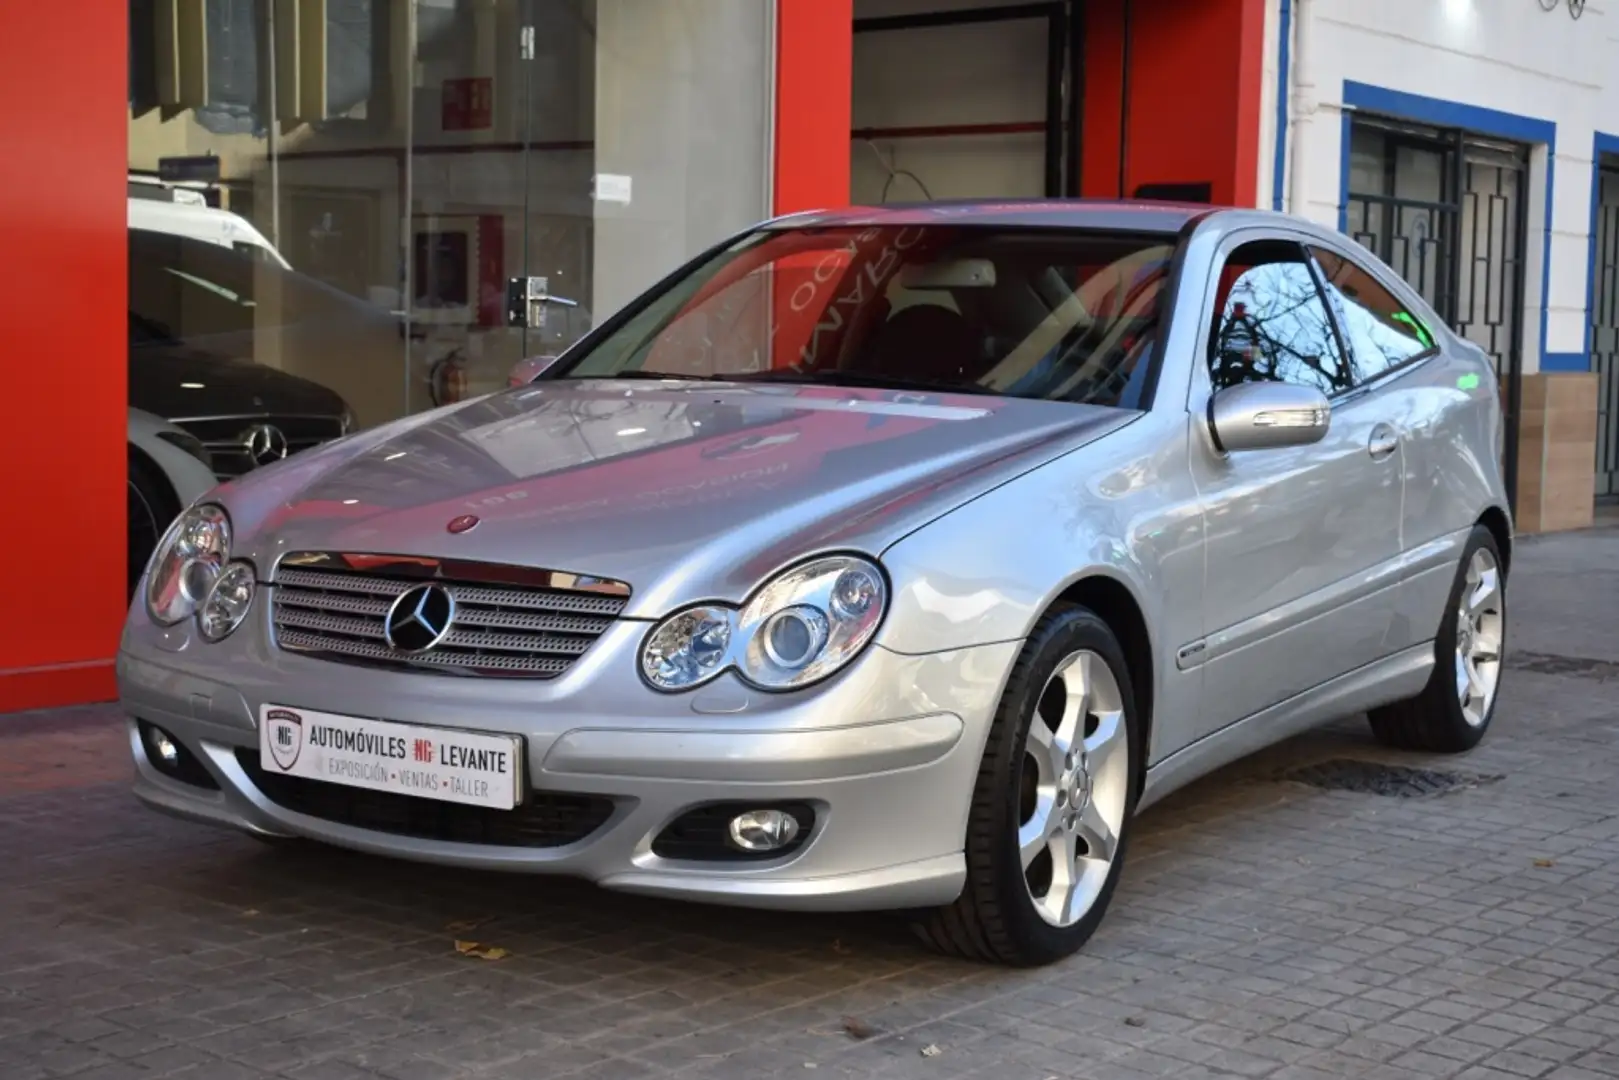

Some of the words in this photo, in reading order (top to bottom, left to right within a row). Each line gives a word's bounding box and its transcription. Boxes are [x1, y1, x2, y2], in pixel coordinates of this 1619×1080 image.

[309, 725, 406, 759] AUTOMÓVILES
[440, 743, 507, 774] LEVANTE
[328, 757, 388, 783] EXPOSICIÓN
[399, 769, 438, 791] VENTAS
[449, 776, 489, 798] TALLER
